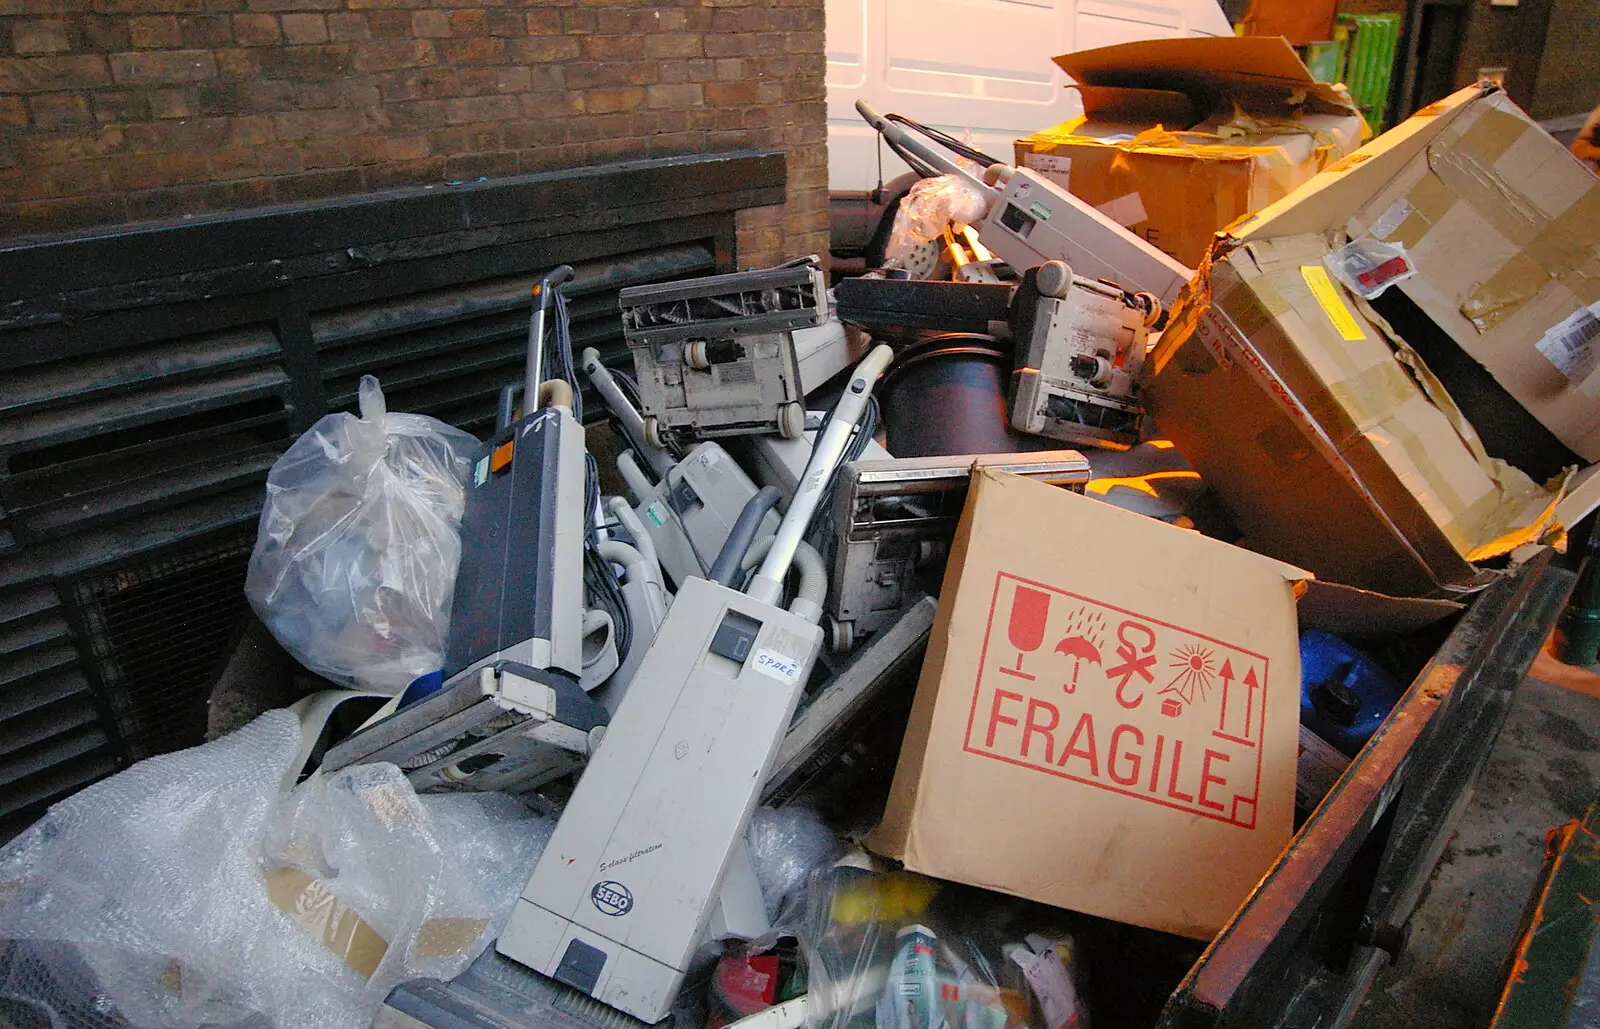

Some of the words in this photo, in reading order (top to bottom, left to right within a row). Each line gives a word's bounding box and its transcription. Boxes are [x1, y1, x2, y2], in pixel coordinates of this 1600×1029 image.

[757, 654, 796, 676] SPARE
[986, 688, 1231, 812] FRAGILE
[595, 888, 629, 910] SEBO
